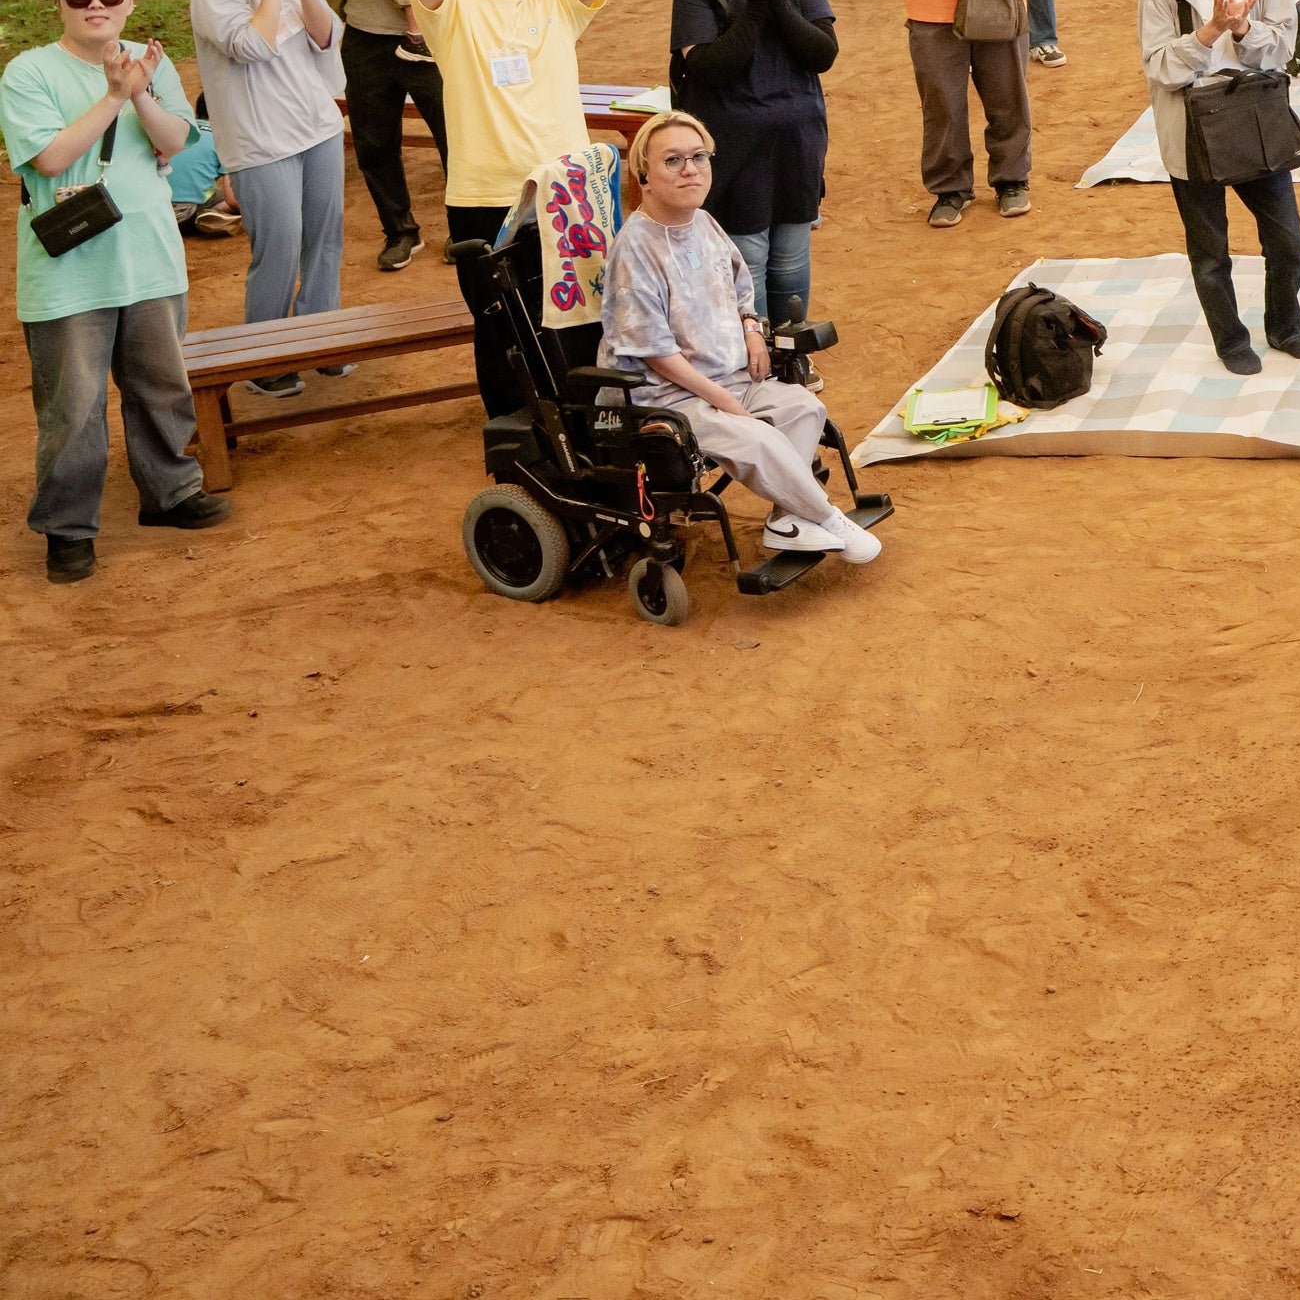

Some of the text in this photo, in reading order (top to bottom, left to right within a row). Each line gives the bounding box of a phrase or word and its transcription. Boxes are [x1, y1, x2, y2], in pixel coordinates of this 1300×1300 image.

[593, 146, 609, 194] Pop Music
[590, 179, 609, 228] Represent
[546, 181, 586, 311] Super
